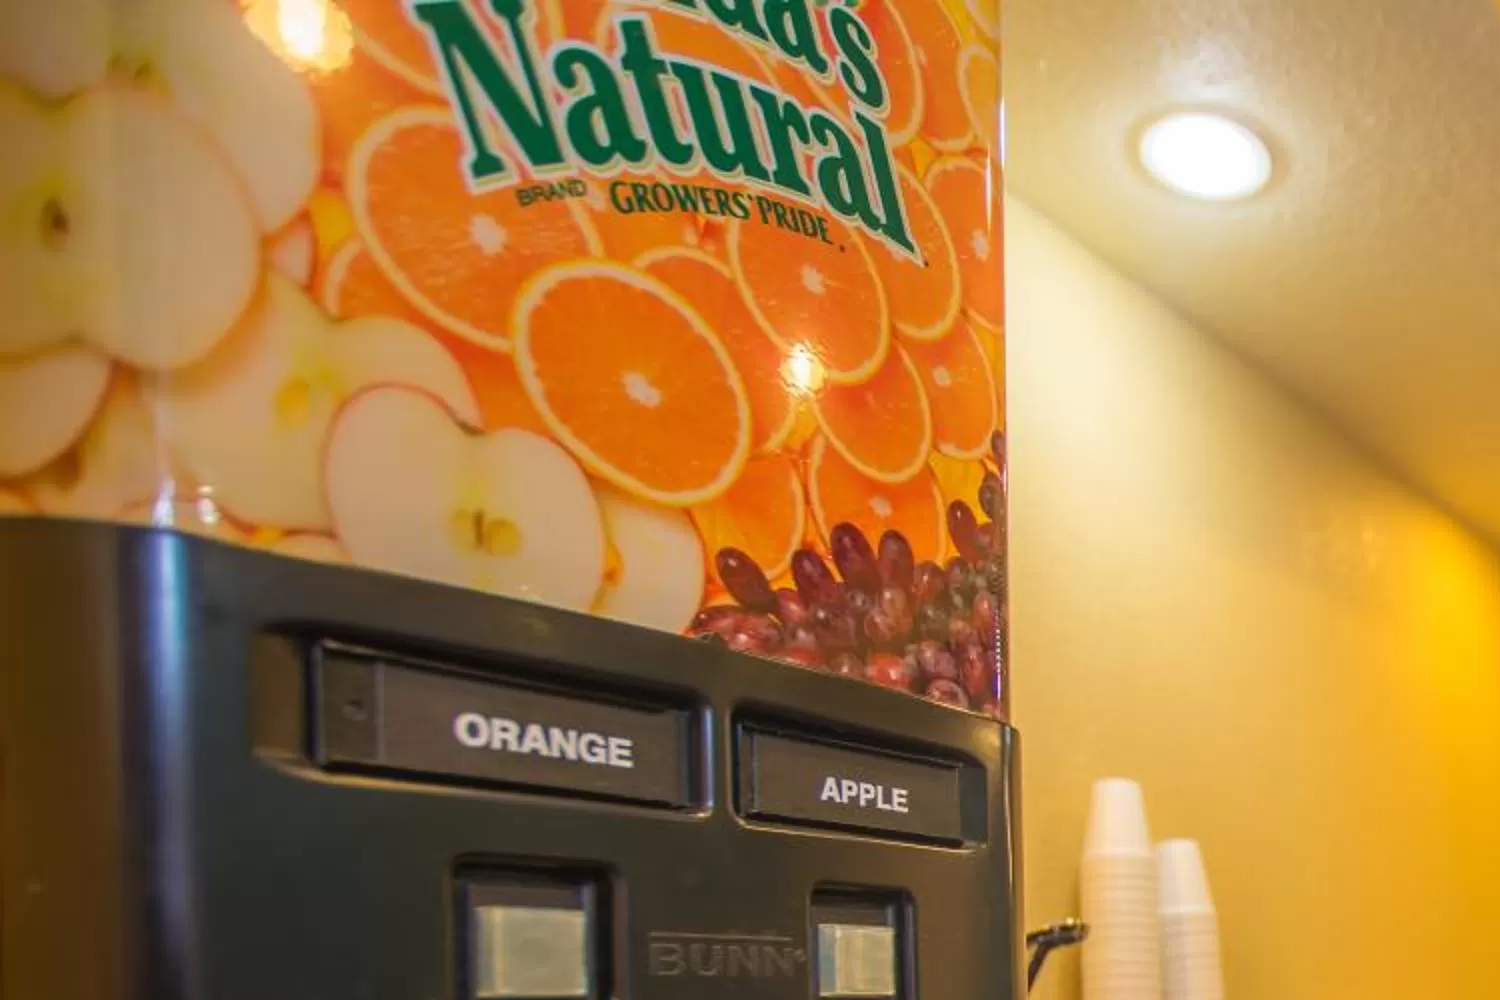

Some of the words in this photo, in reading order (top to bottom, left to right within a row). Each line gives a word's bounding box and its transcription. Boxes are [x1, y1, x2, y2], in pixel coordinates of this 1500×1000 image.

[414, 0, 916, 255] Natural
[516, 179, 587, 206] BRAND
[453, 713, 634, 768] ORANGE
[820, 776, 909, 813] APPLE
[649, 943, 796, 977] BUNN
